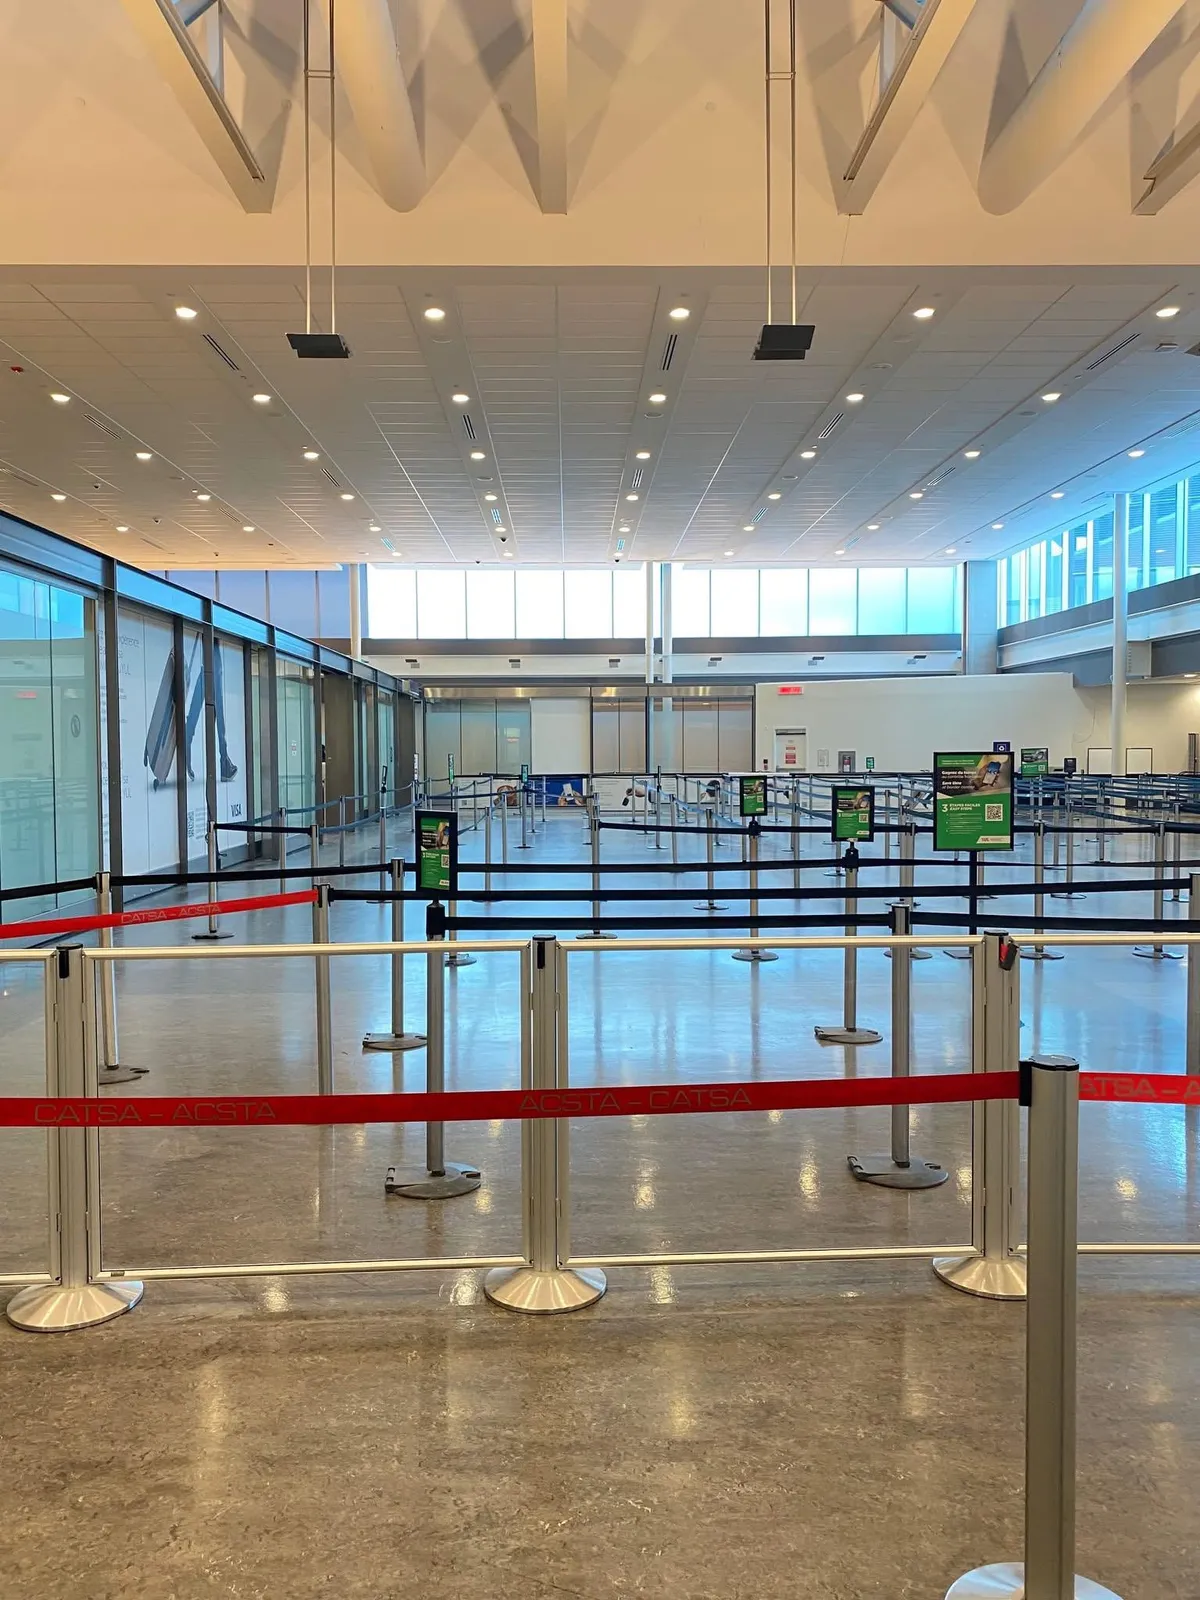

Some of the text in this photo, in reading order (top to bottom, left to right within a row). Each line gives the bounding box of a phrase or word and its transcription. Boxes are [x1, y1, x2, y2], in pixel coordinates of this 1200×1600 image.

[230, 803, 242, 817] VISA
[942, 804, 948, 812] 3
[120, 911, 167, 924] CATSA
[178, 904, 221, 917] ACSTA
[1079, 1076, 1156, 1099] ATSA
[519, 1092, 620, 1113] ACSTA
[649, 1087, 752, 1109] CATSA
[34, 1103, 142, 1123] CATSA
[172, 1102, 276, 1121] ACSTA
